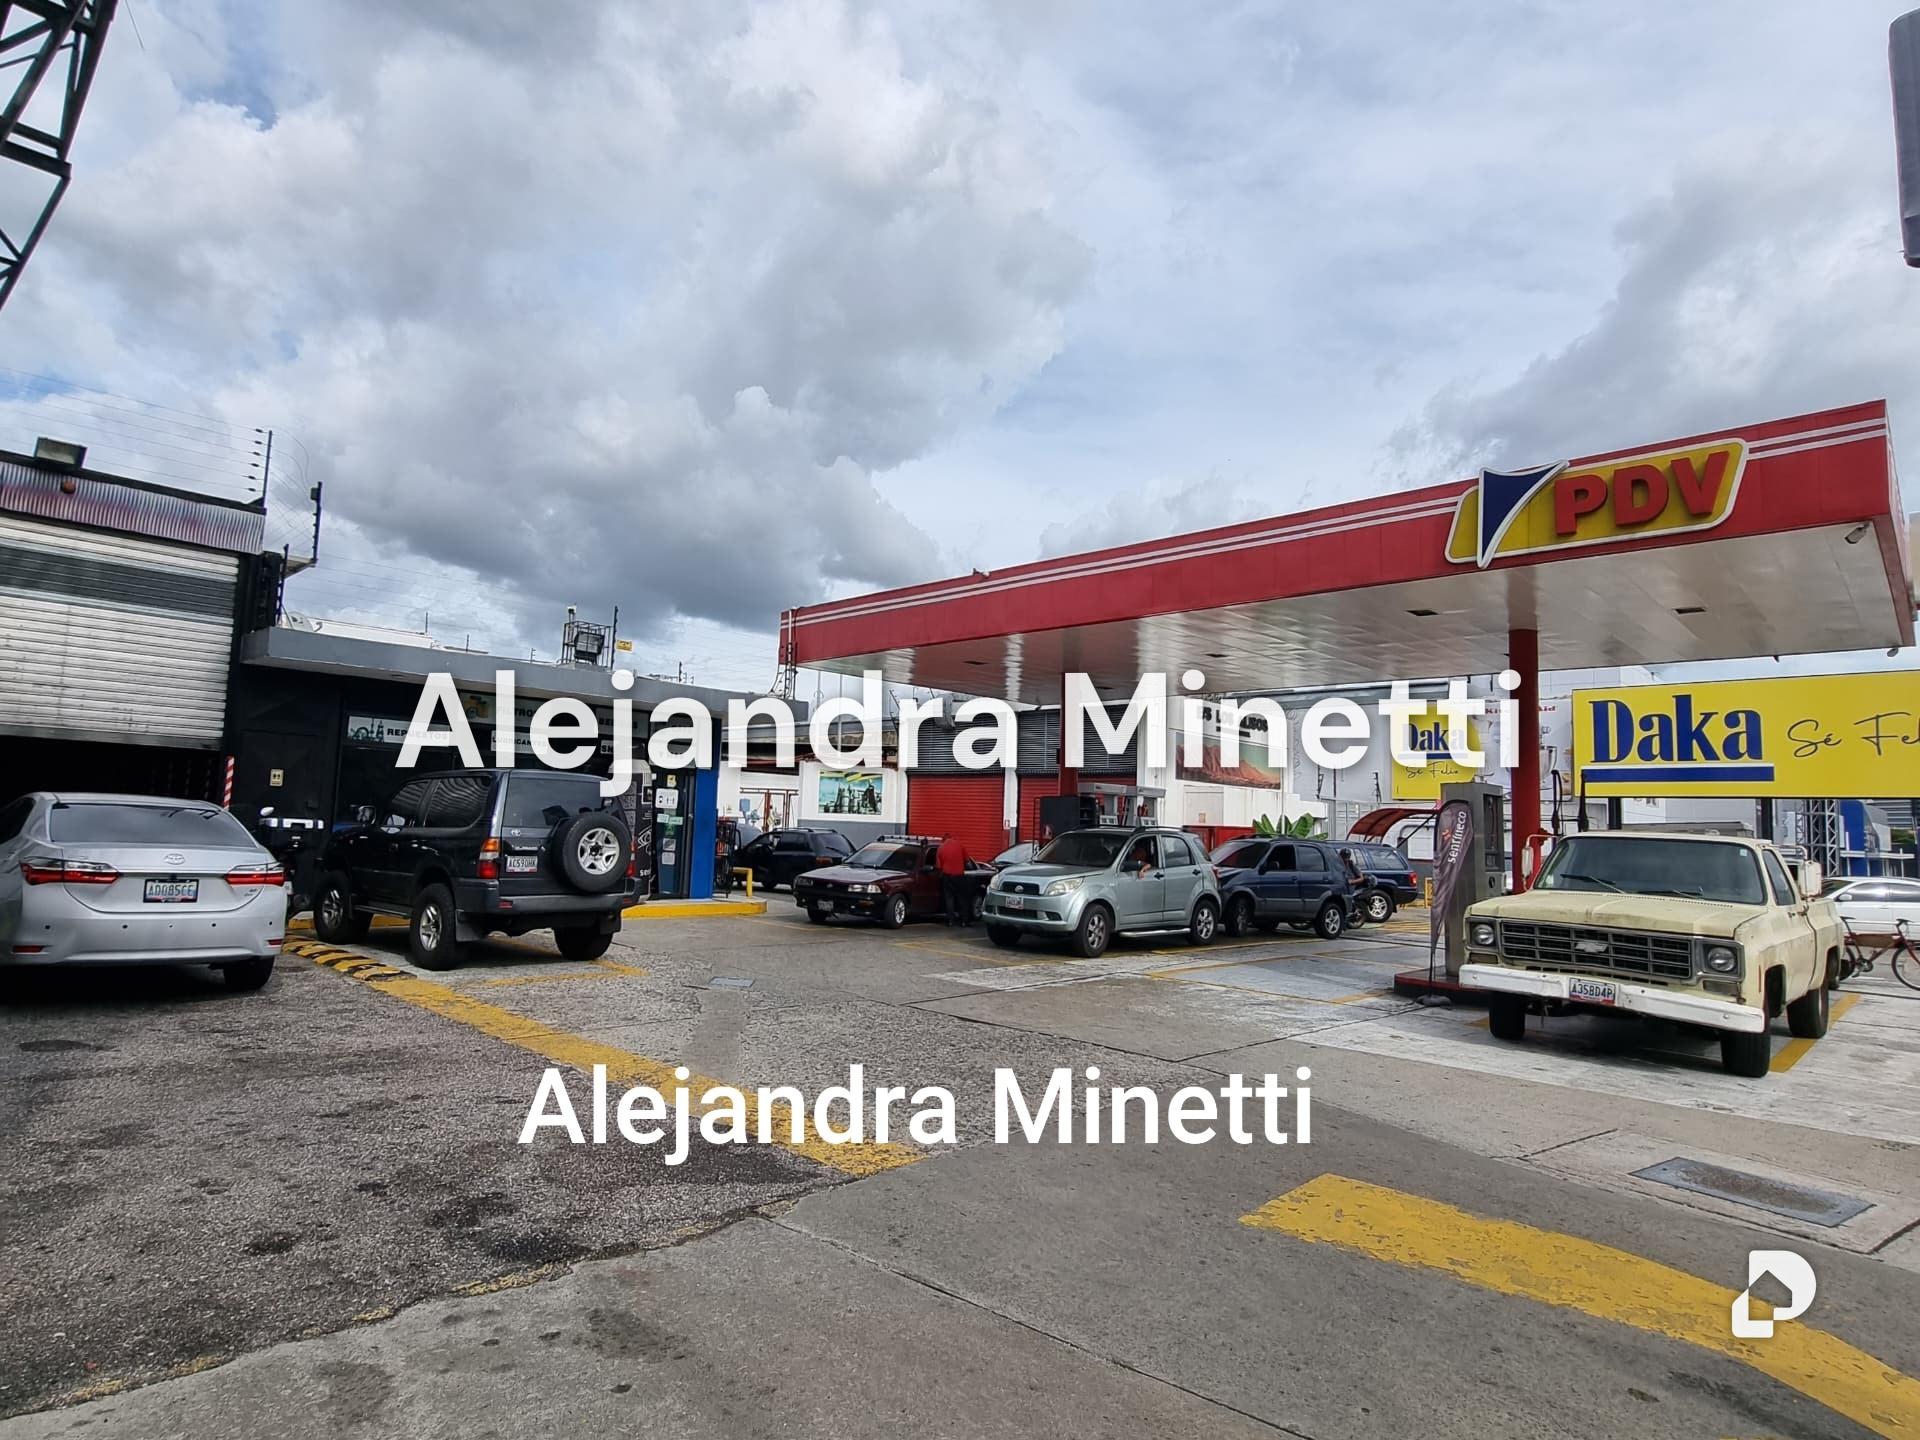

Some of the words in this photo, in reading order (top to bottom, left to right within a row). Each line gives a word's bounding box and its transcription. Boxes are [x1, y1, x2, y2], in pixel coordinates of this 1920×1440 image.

[1554, 450, 1730, 536] PDV
[1401, 722, 1465, 751] Daka
[1589, 694, 1763, 764] Daka
[1786, 718, 1842, 758] Sé
[1571, 983, 1613, 998] A35BD4P
